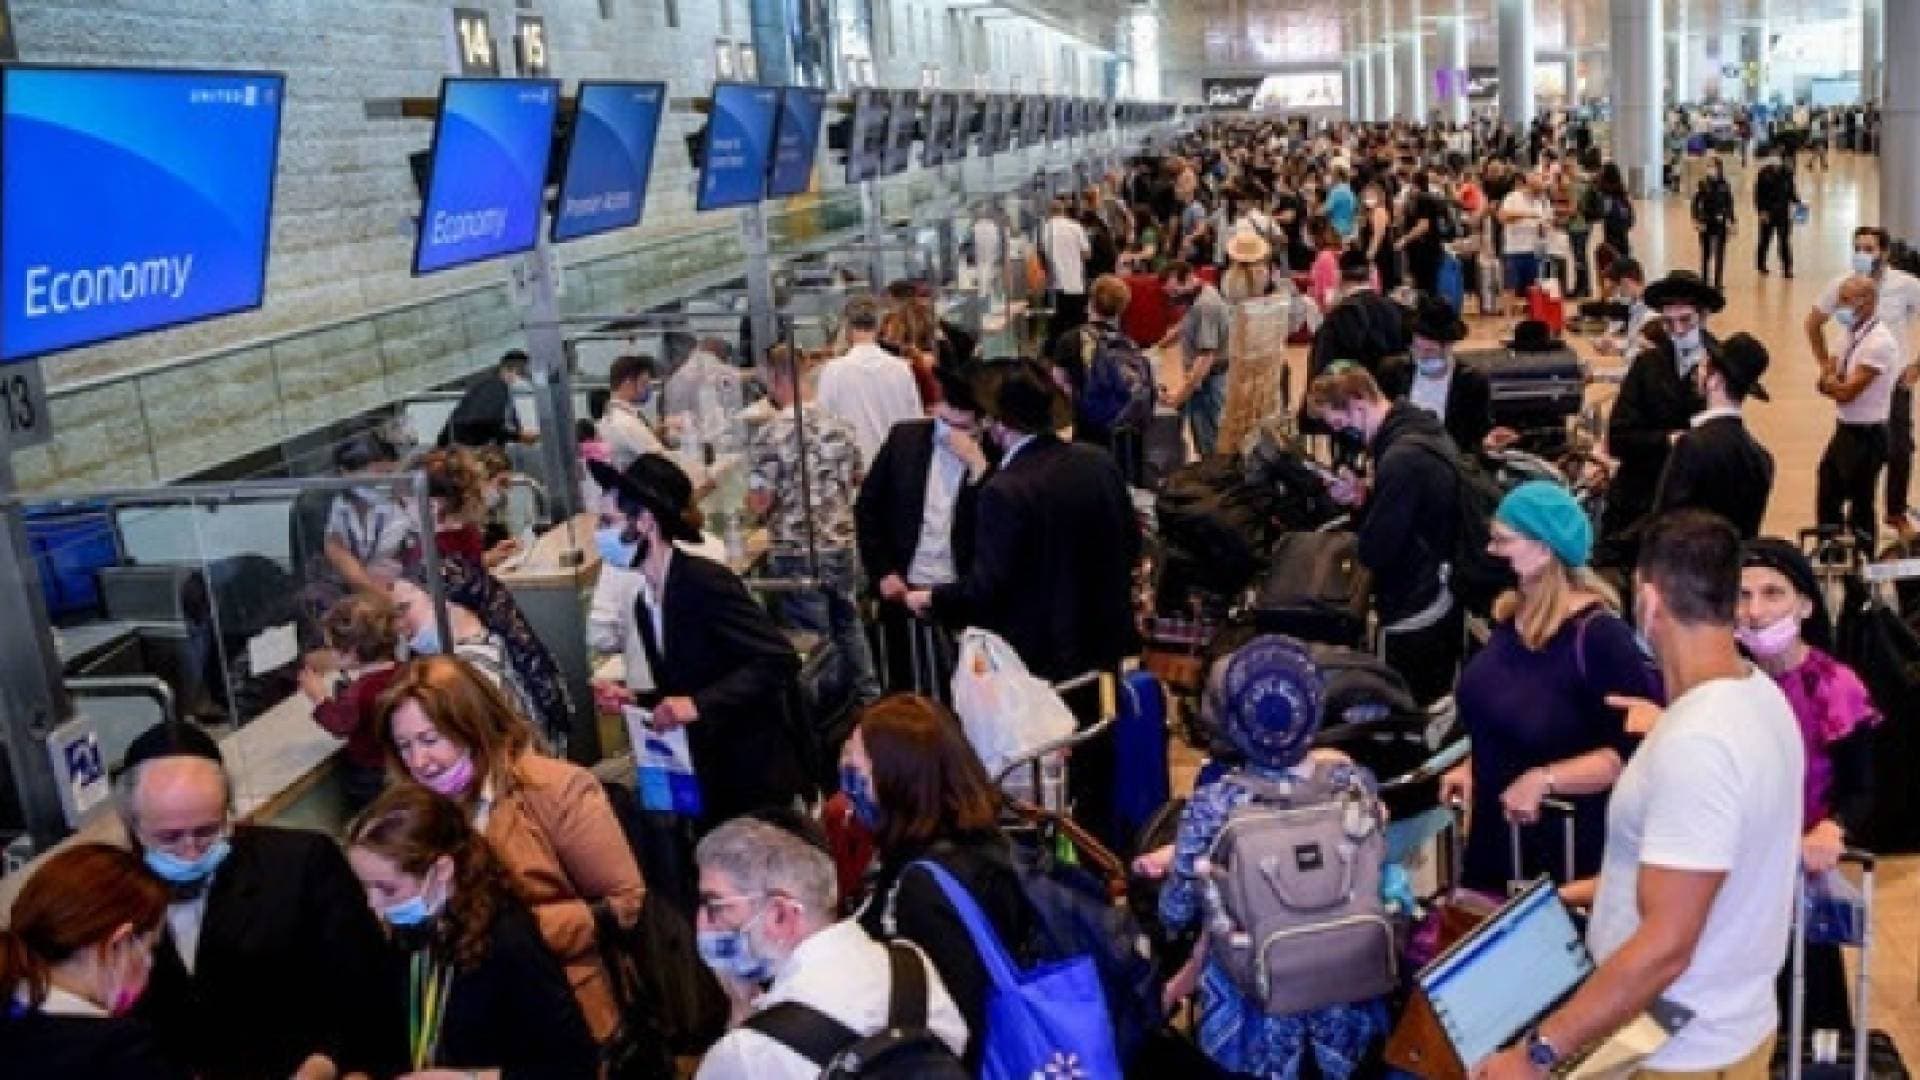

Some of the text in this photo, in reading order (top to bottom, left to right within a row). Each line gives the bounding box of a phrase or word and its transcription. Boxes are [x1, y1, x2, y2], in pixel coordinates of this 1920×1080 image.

[461, 18, 490, 63] 14
[432, 207, 507, 245] Economy
[26, 253, 193, 319] Economy
[1, 374, 36, 433] 13
